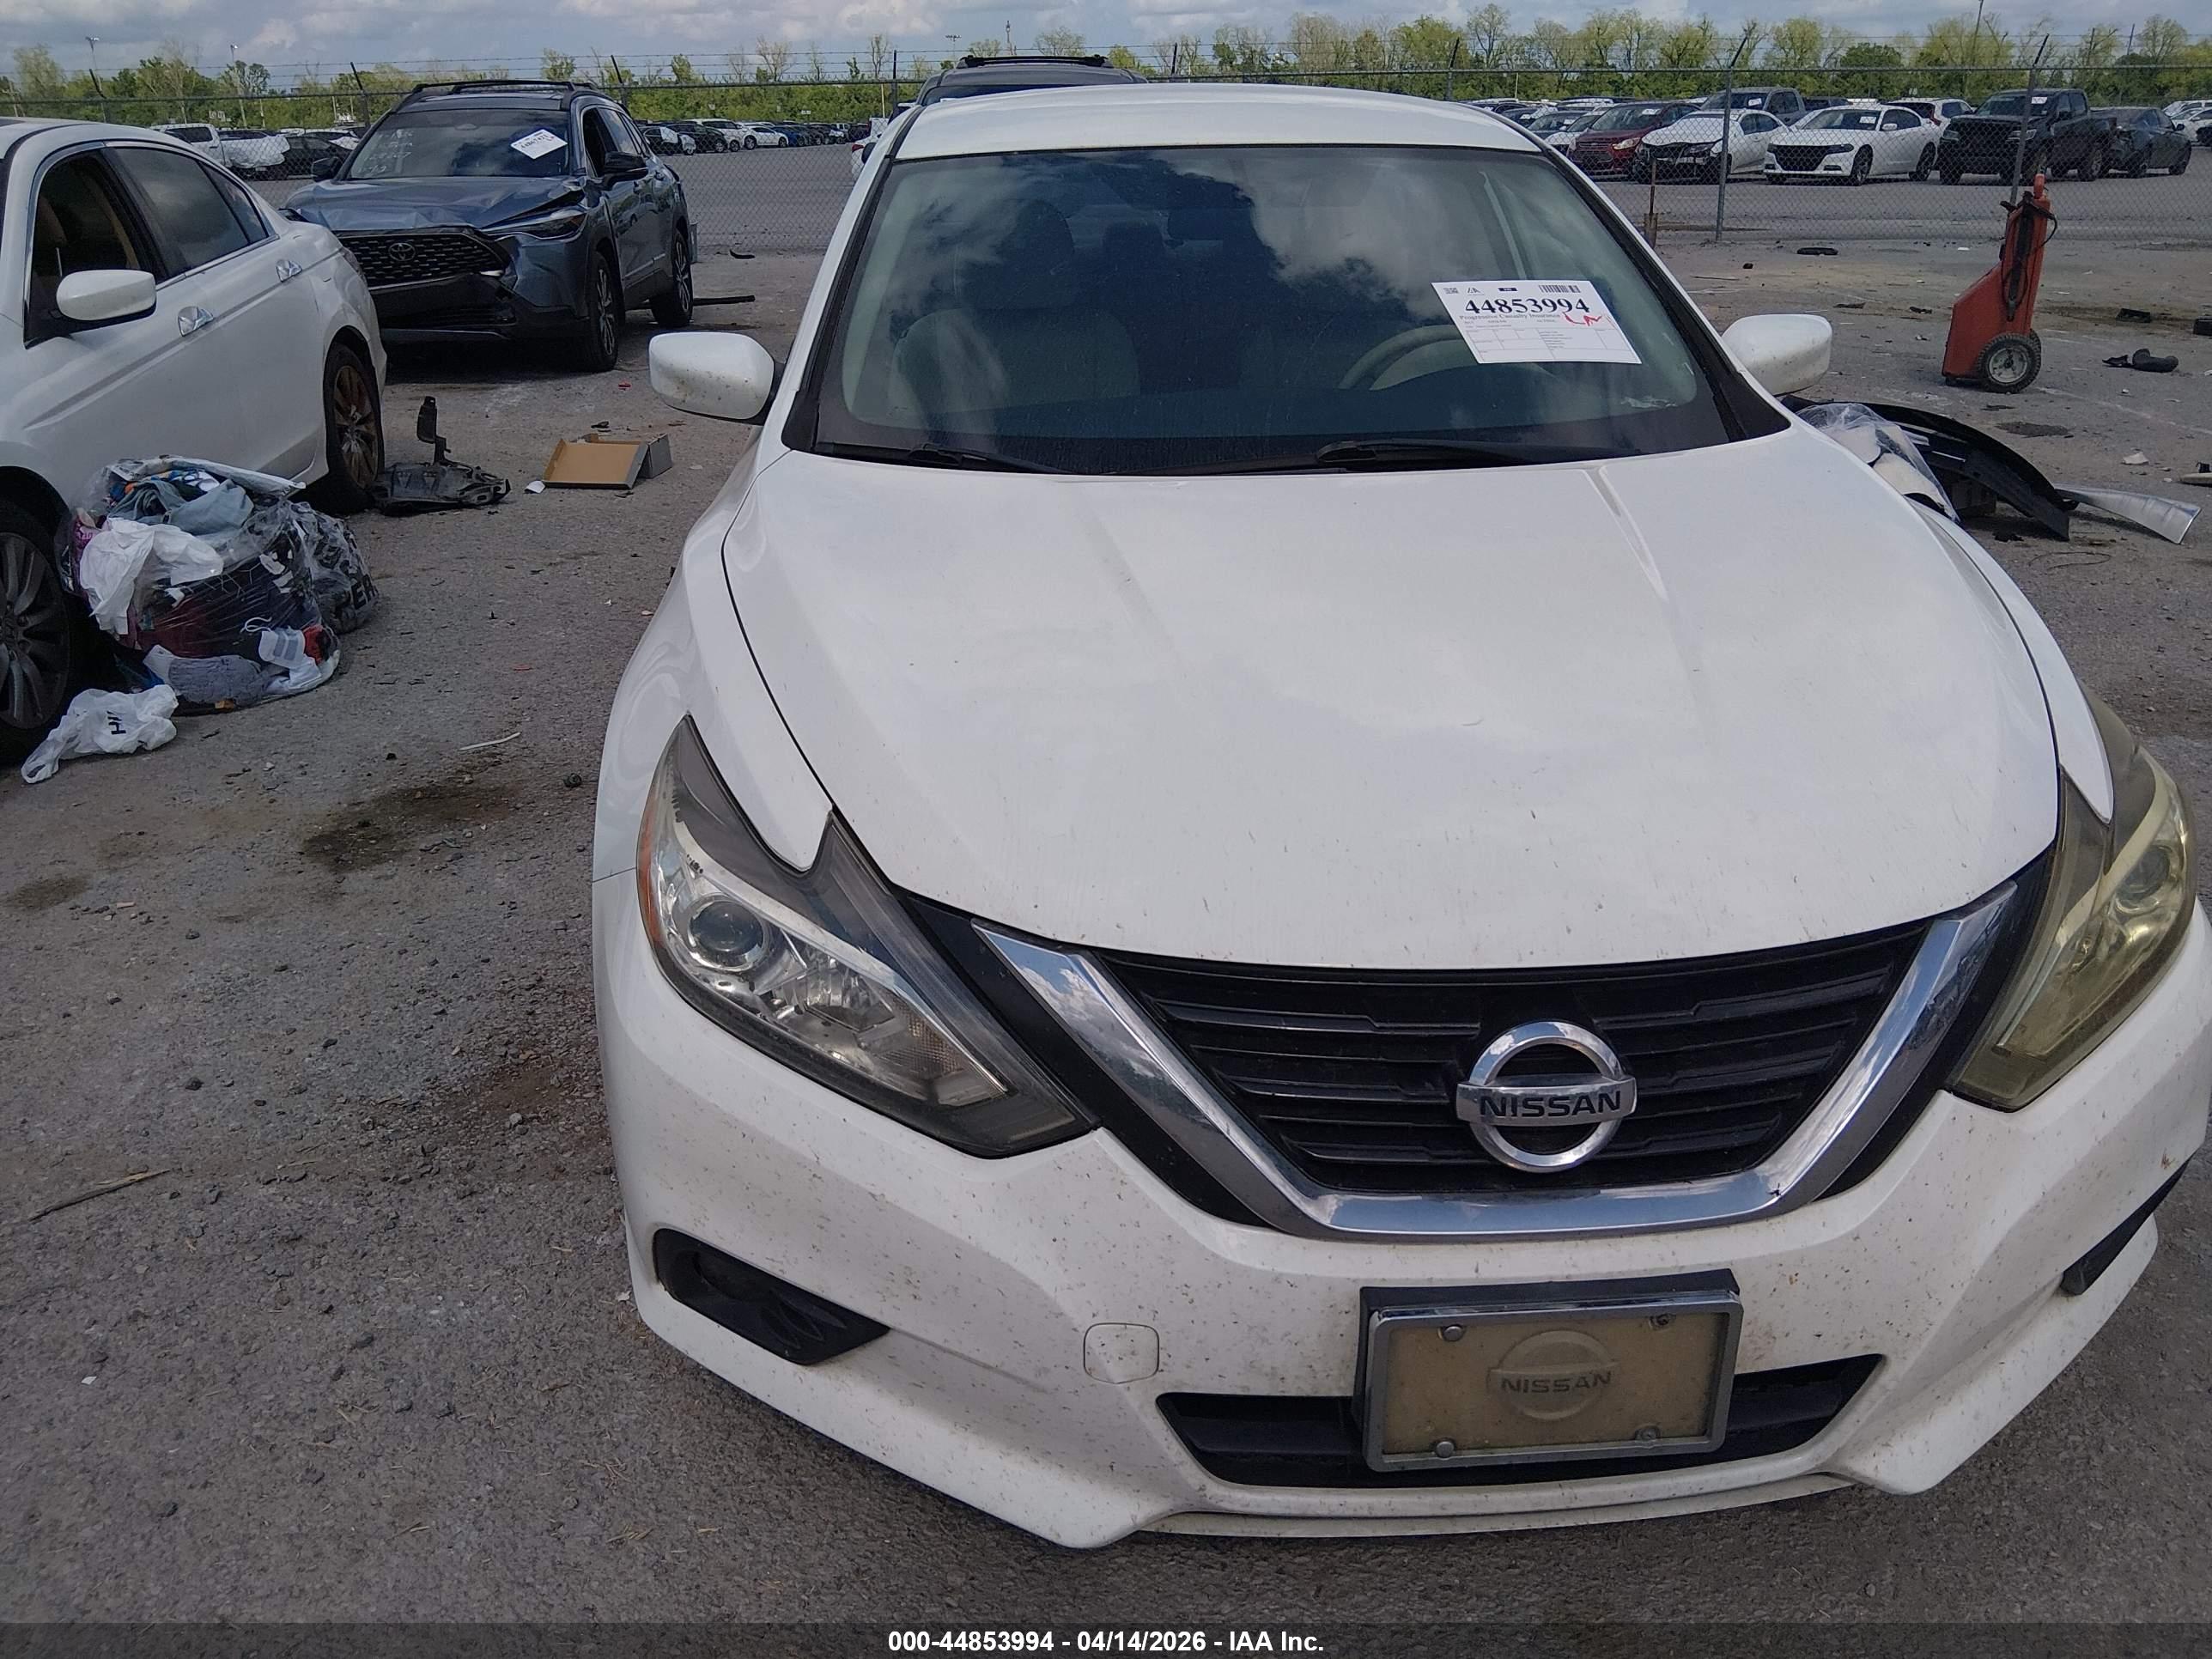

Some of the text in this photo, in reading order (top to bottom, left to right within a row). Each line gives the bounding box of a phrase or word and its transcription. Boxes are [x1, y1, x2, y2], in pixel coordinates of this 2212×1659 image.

[1465, 298, 1590, 314] 44853994
[1480, 1090, 1621, 1118] NISSAN
[1500, 1370, 1612, 1393] NISSAN
